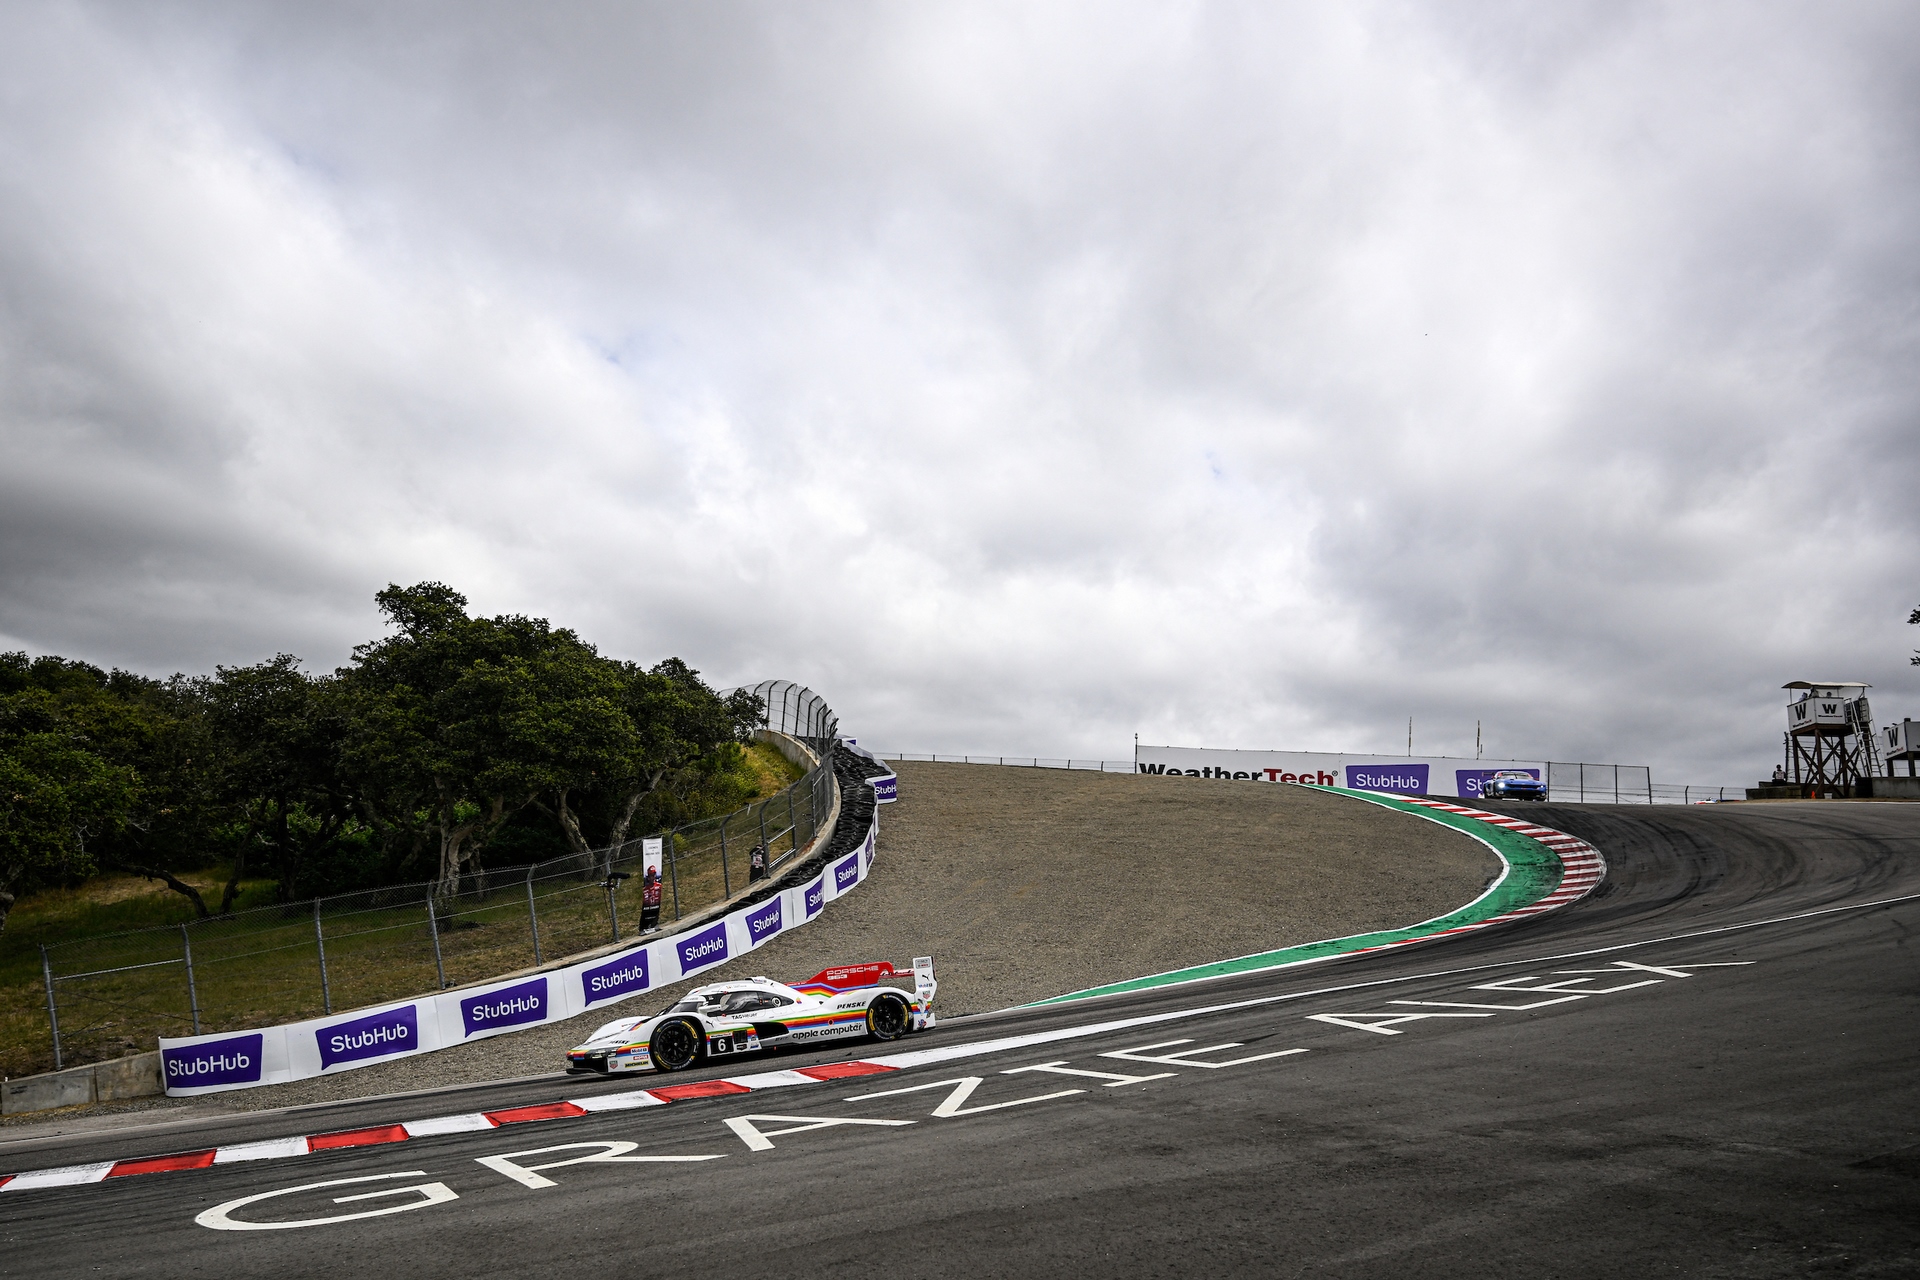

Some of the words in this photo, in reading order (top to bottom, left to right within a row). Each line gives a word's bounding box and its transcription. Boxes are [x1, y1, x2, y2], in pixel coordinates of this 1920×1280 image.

[1795, 702, 1807, 721] W
[1821, 703, 1837, 715] W
[1887, 727, 1898, 748] W
[1355, 773, 1420, 789] StubHub
[838, 864, 858, 883] StubHub
[753, 909, 780, 933] StubHub
[685, 936, 724, 961] StubHub
[591, 965, 643, 992] StubHub
[826, 965, 879, 976] PORSCHE
[472, 995, 540, 1021] StubHub
[837, 1001, 867, 1010] PENSKE
[330, 1023, 409, 1053] StubHub
[717, 1038, 727, 1052] 6
[792, 1030, 819, 1040] apple
[169, 1052, 250, 1077] StubHub
[194, 1039, 1310, 1232] GRAZIE
[1305, 961, 1757, 1035] ALEX
